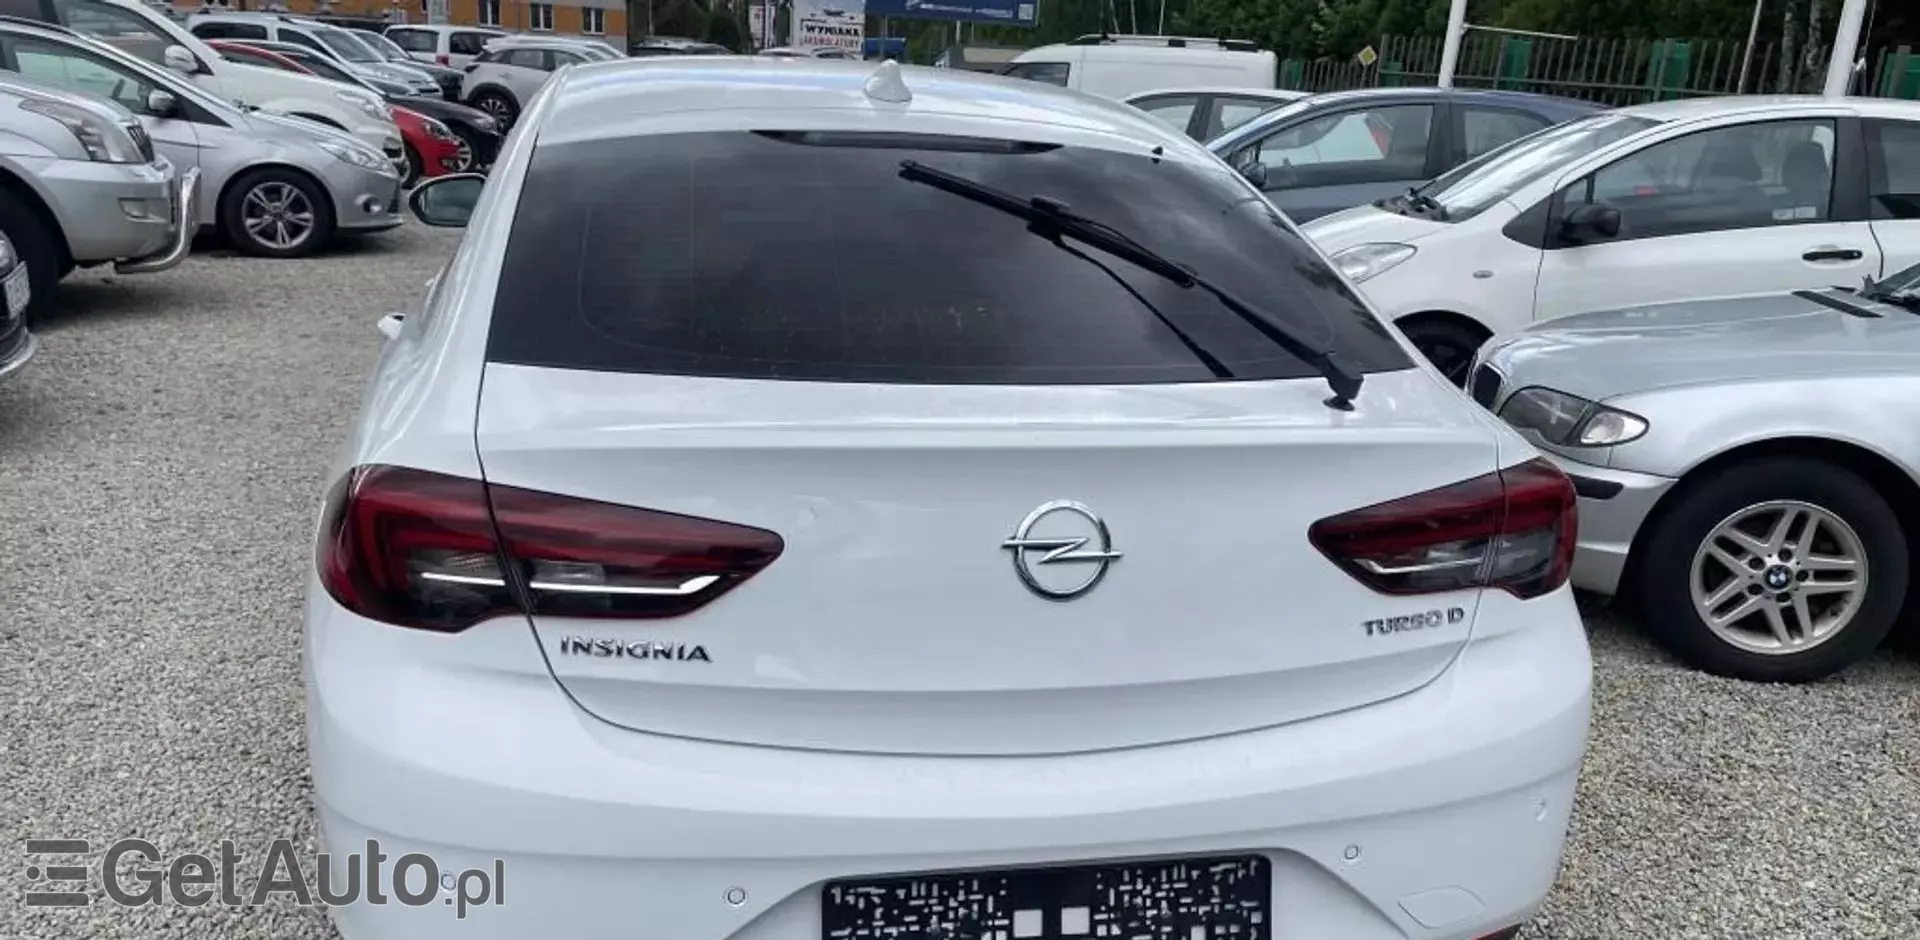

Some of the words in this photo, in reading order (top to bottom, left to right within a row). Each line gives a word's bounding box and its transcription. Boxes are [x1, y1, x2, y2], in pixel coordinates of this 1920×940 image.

[1362, 609, 1443, 637] TURBO
[1447, 607, 1464, 624] D
[560, 635, 712, 663] INSIGNIA
